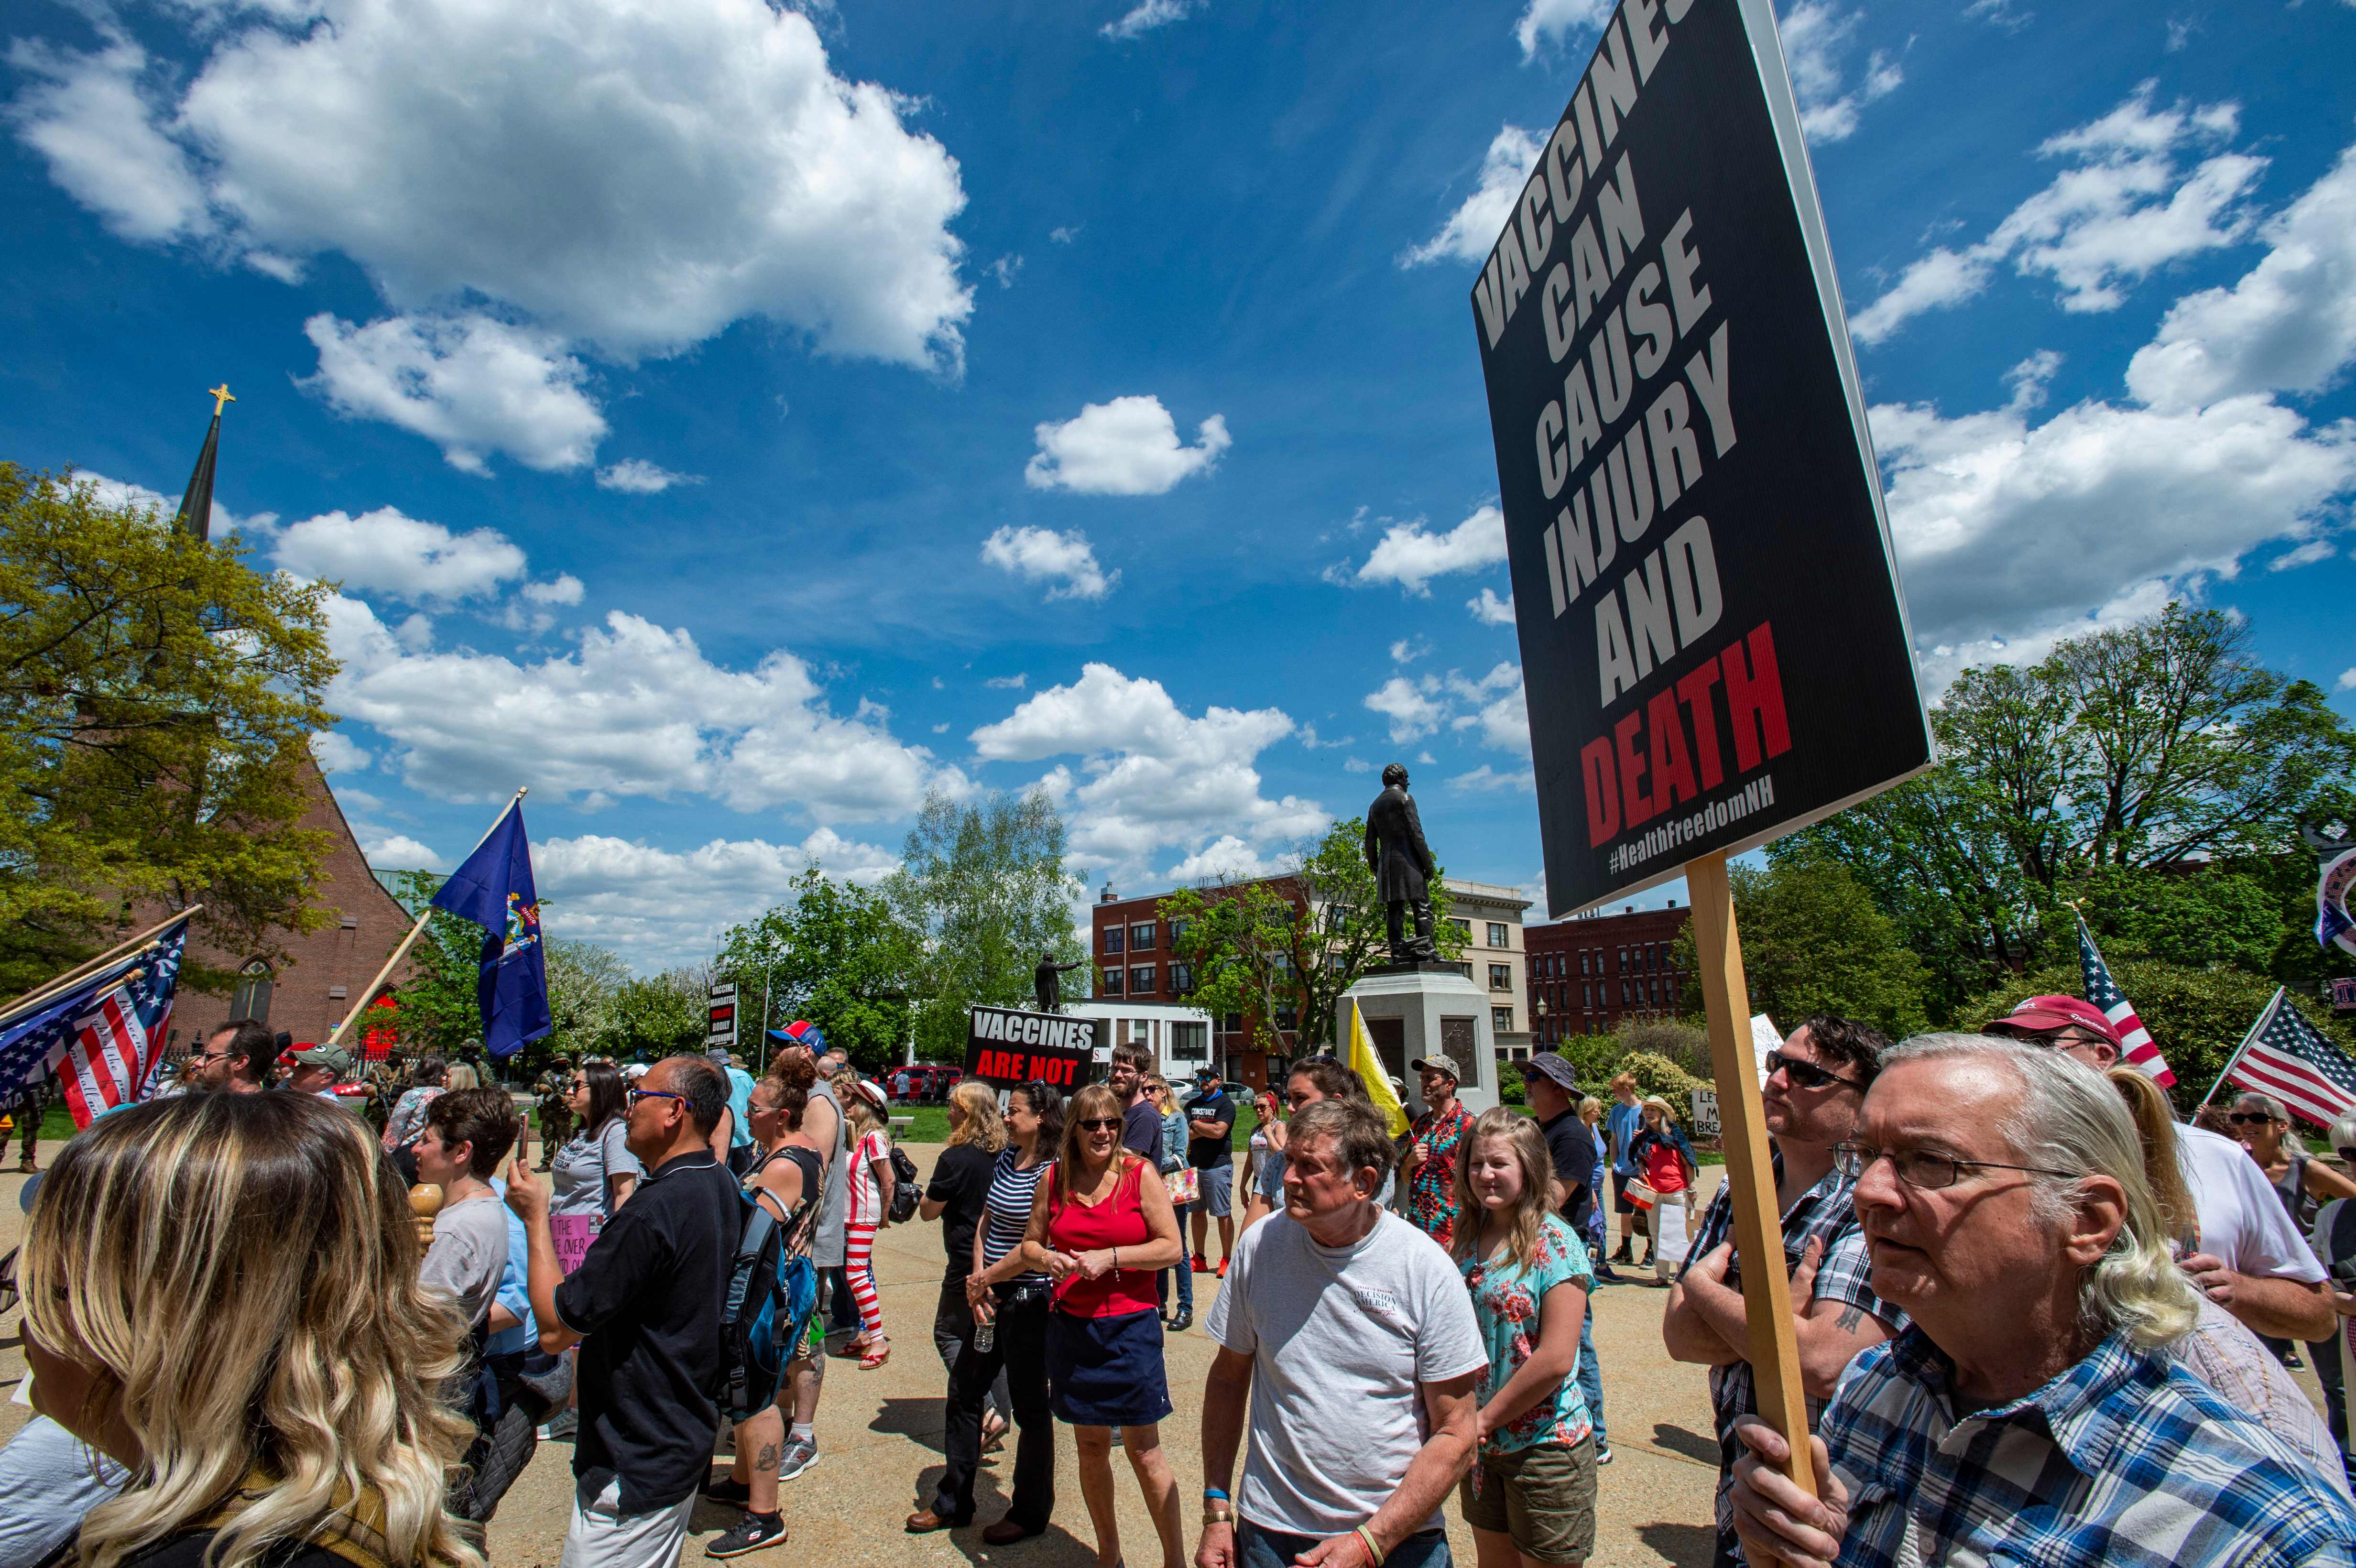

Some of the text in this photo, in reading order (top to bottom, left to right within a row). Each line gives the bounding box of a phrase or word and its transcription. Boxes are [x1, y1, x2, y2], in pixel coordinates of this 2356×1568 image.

[1475, 0, 1694, 351] VACCINE
[1542, 149, 1645, 364] CAN
[1536, 207, 1712, 500] CAUSE
[1543, 320, 1736, 620] INJURY
[1596, 515, 1723, 709] AND
[1580, 620, 1792, 849] DEATH
[1609, 774, 1775, 875] #HealthFreedomNH
[521, 907, 537, 924] DIRIGO
[712, 983, 734, 995] VACCINE
[710, 995, 735, 1008] MANDATES
[712, 1020, 730, 1032] BODILY
[974, 1011, 1093, 1050] VACCINES
[709, 1033, 734, 1044] AUTONOMY
[91, 1016, 112, 1039] ight
[113, 1079, 127, 1102] peo
[976, 1050, 1078, 1085] ARE NOT
[1706, 1107, 1721, 1121] M
[1697, 1120, 1722, 1134] BRE
[557, 1219, 572, 1235] THE
[564, 1238, 586, 1254] OVER
[1353, 1291, 1396, 1306] DECISION
[1356, 1298, 1395, 1311] AMERICA
